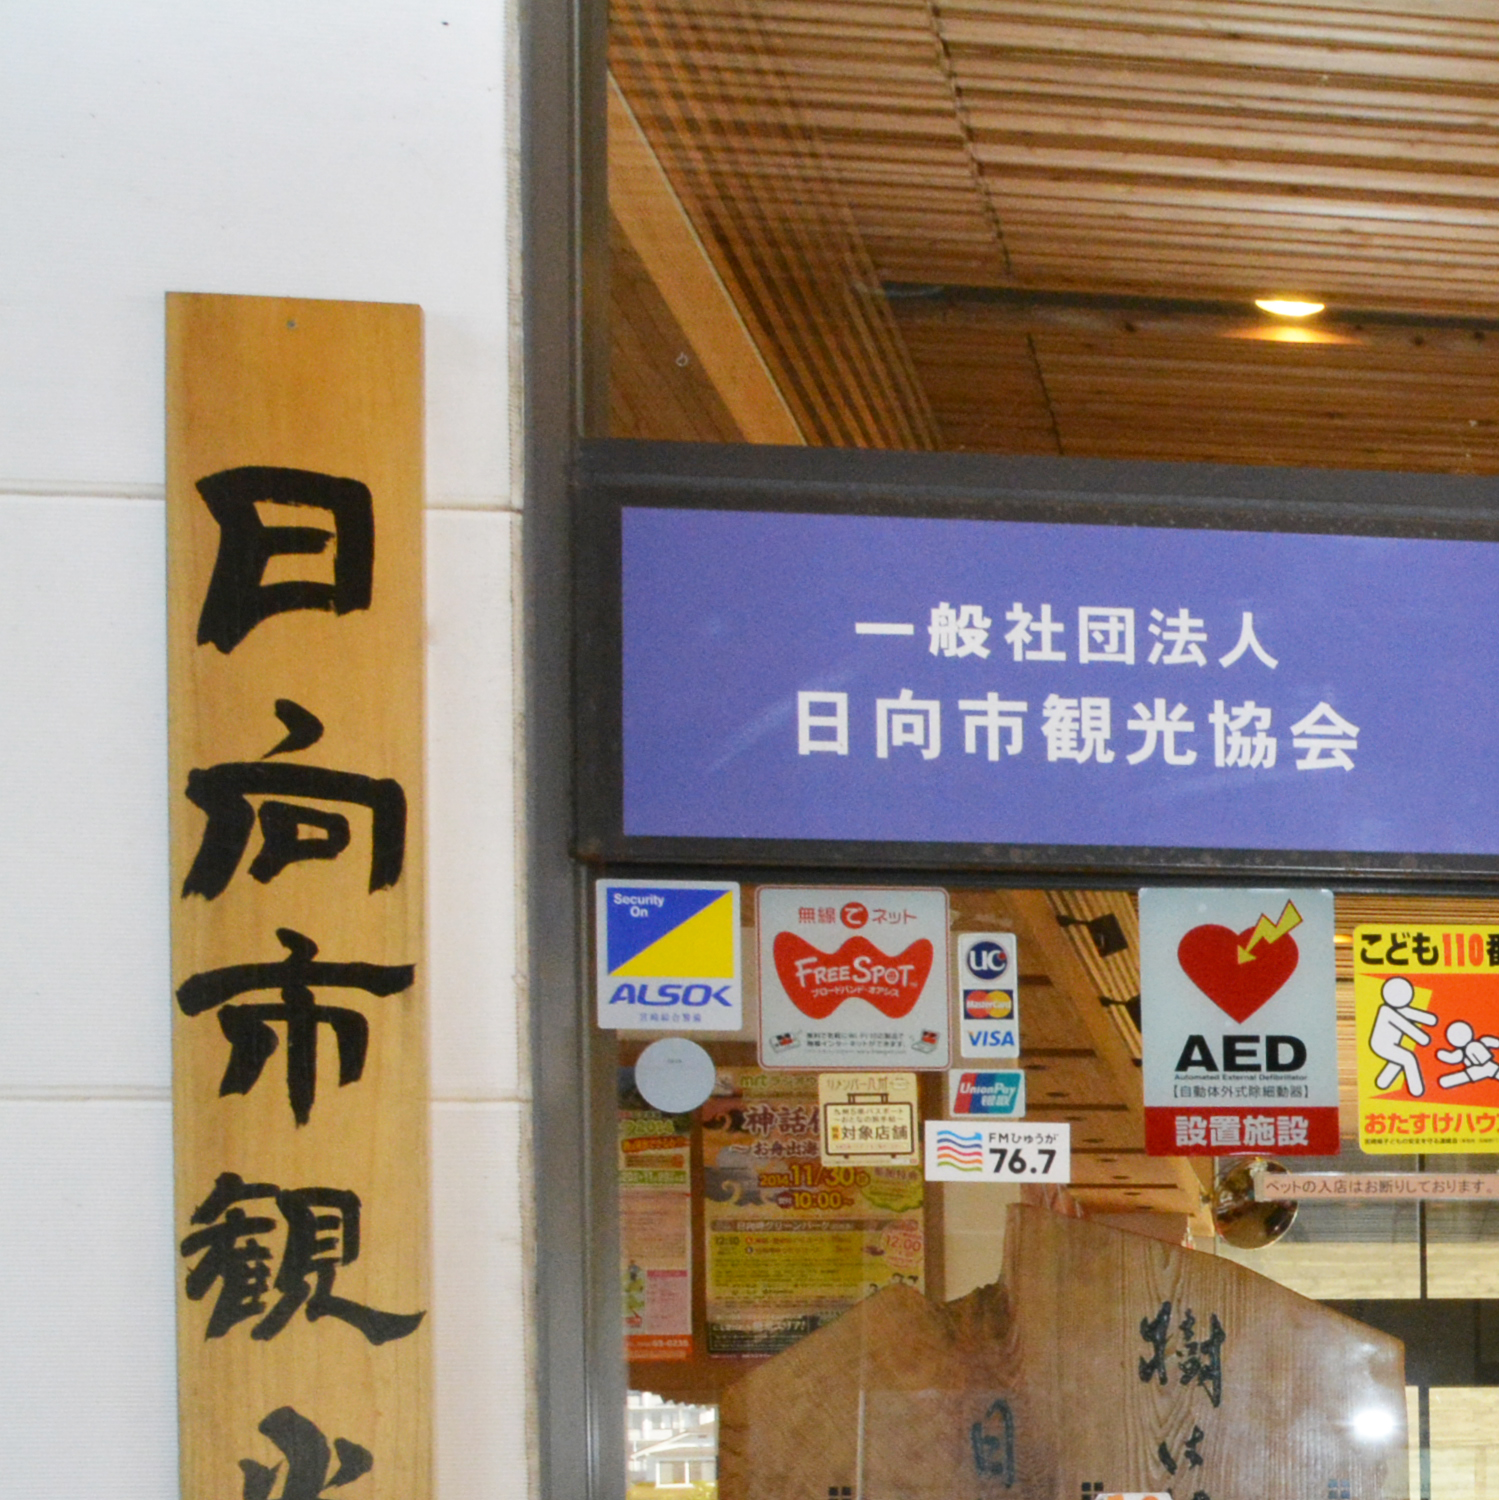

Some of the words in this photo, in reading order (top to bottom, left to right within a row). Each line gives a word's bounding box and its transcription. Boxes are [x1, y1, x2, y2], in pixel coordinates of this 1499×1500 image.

[855, 602, 1279, 670] 一般社団法人
[797, 689, 1361, 772] 日向市観光協会
[613, 894, 664, 908] Security
[630, 907, 648, 918] On
[797, 903, 918, 928] 無線でネット
[609, 983, 733, 1008] ALSOK
[966, 998, 1012, 1010] MasterCard
[969, 1030, 1015, 1047] VISA
[1174, 1035, 1308, 1073] AED
[1174, 1073, 1219, 1081] Automated
[1222, 1073, 1258, 1081] External
[959, 1081, 1017, 1100] UnionPay
[841, 1125, 908, 1140] 対象店舗
[989, 1132, 1059, 1145] FMひゅうが
[1174, 1116, 1309, 1149] 設置施設
[989, 1149, 1058, 1175] 76.7
[1265, 1178, 1495, 1197] ペットの入店はお断りしております。
